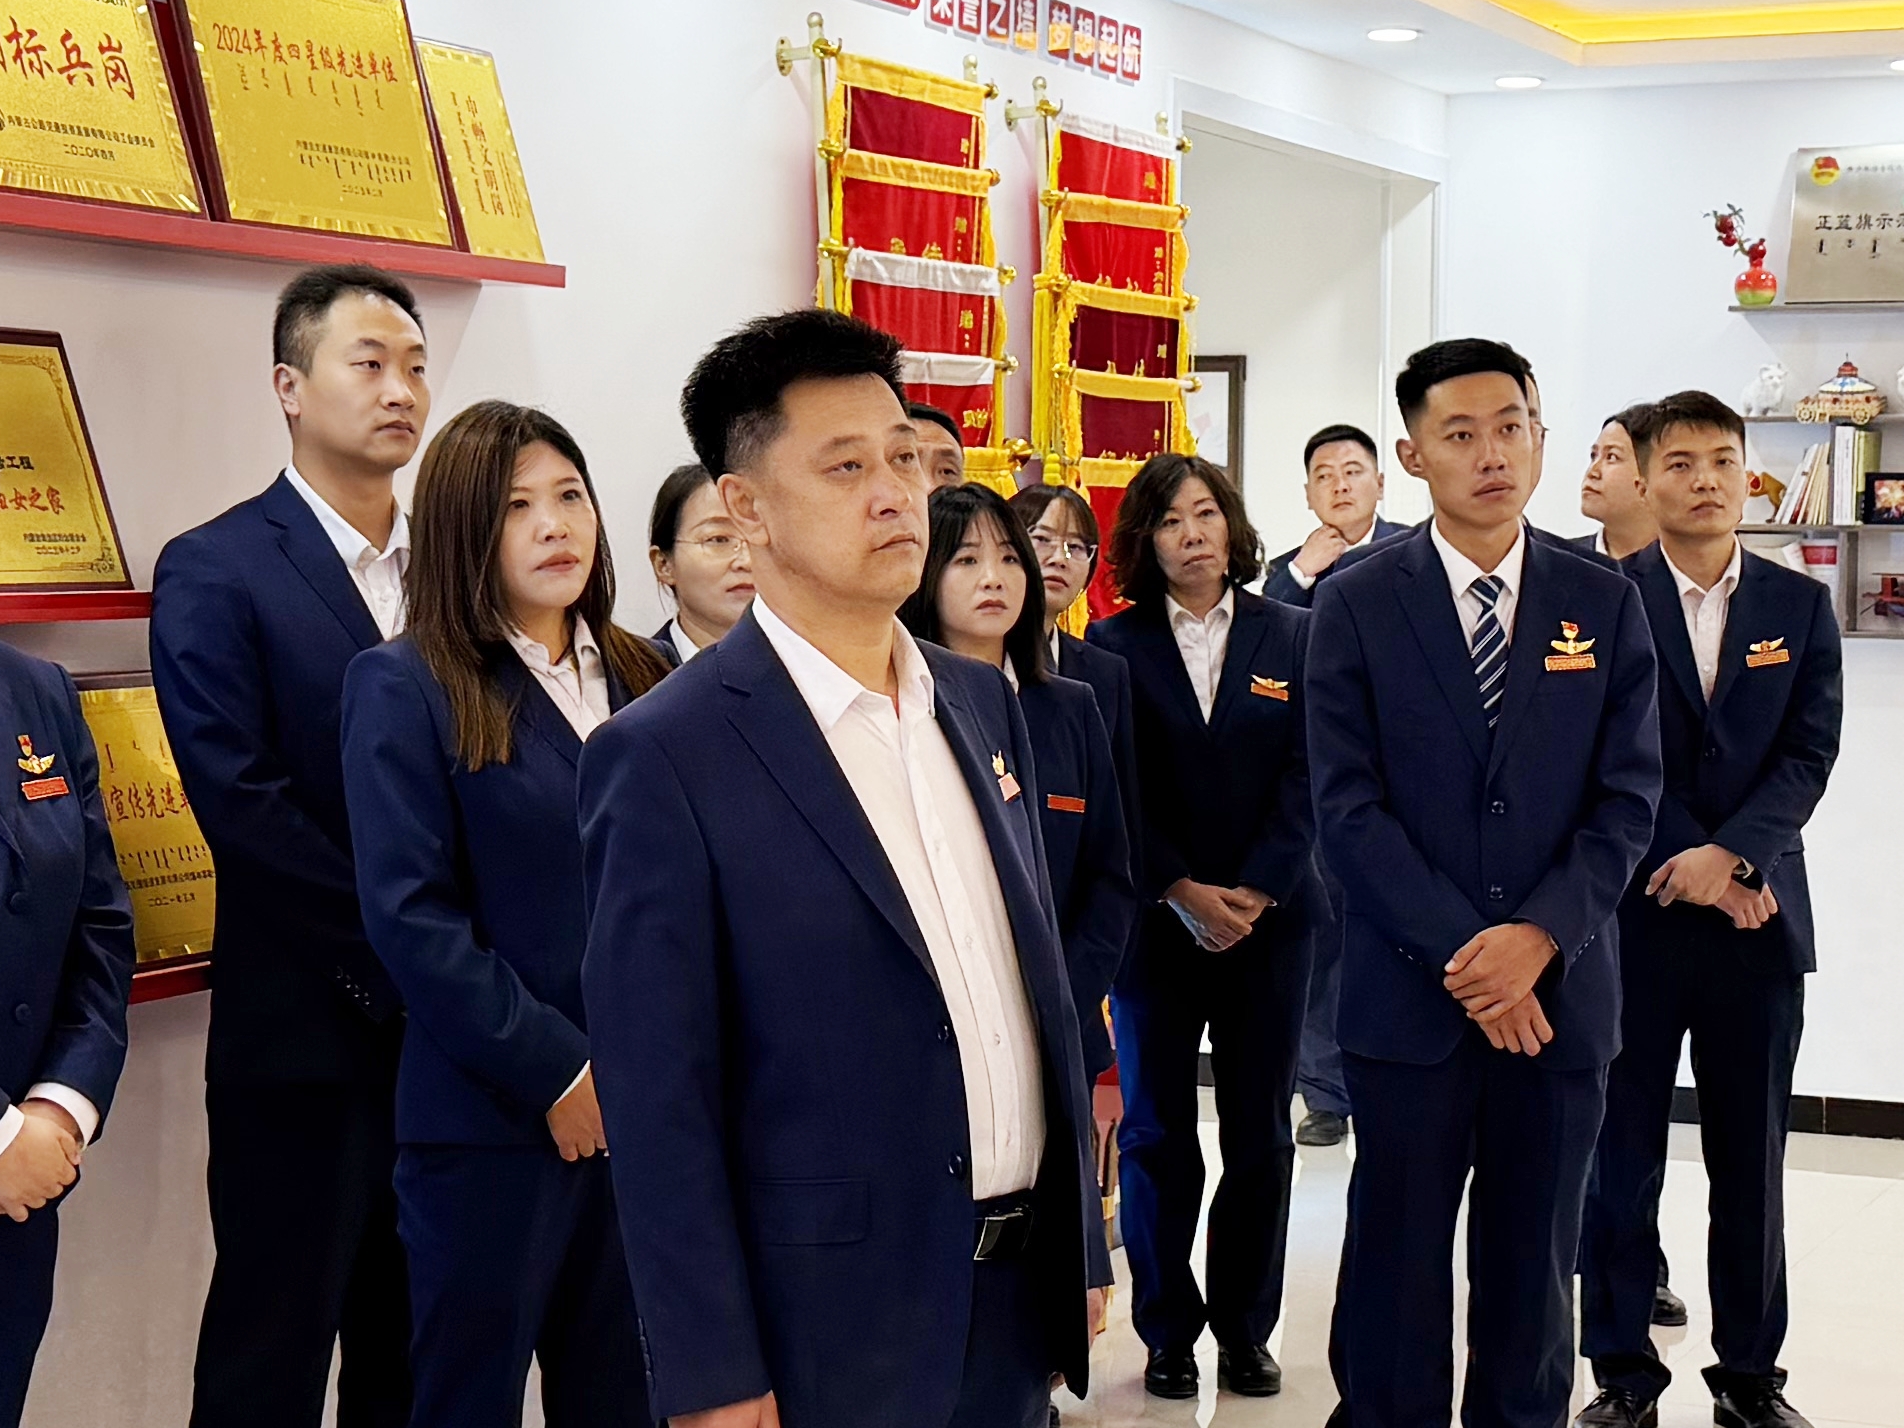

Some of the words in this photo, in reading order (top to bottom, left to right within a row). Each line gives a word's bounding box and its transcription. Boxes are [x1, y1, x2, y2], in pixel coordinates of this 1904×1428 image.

[1048, 5, 1140, 75] 梦想起航
[105, 780, 189, 823] 宣传先进
